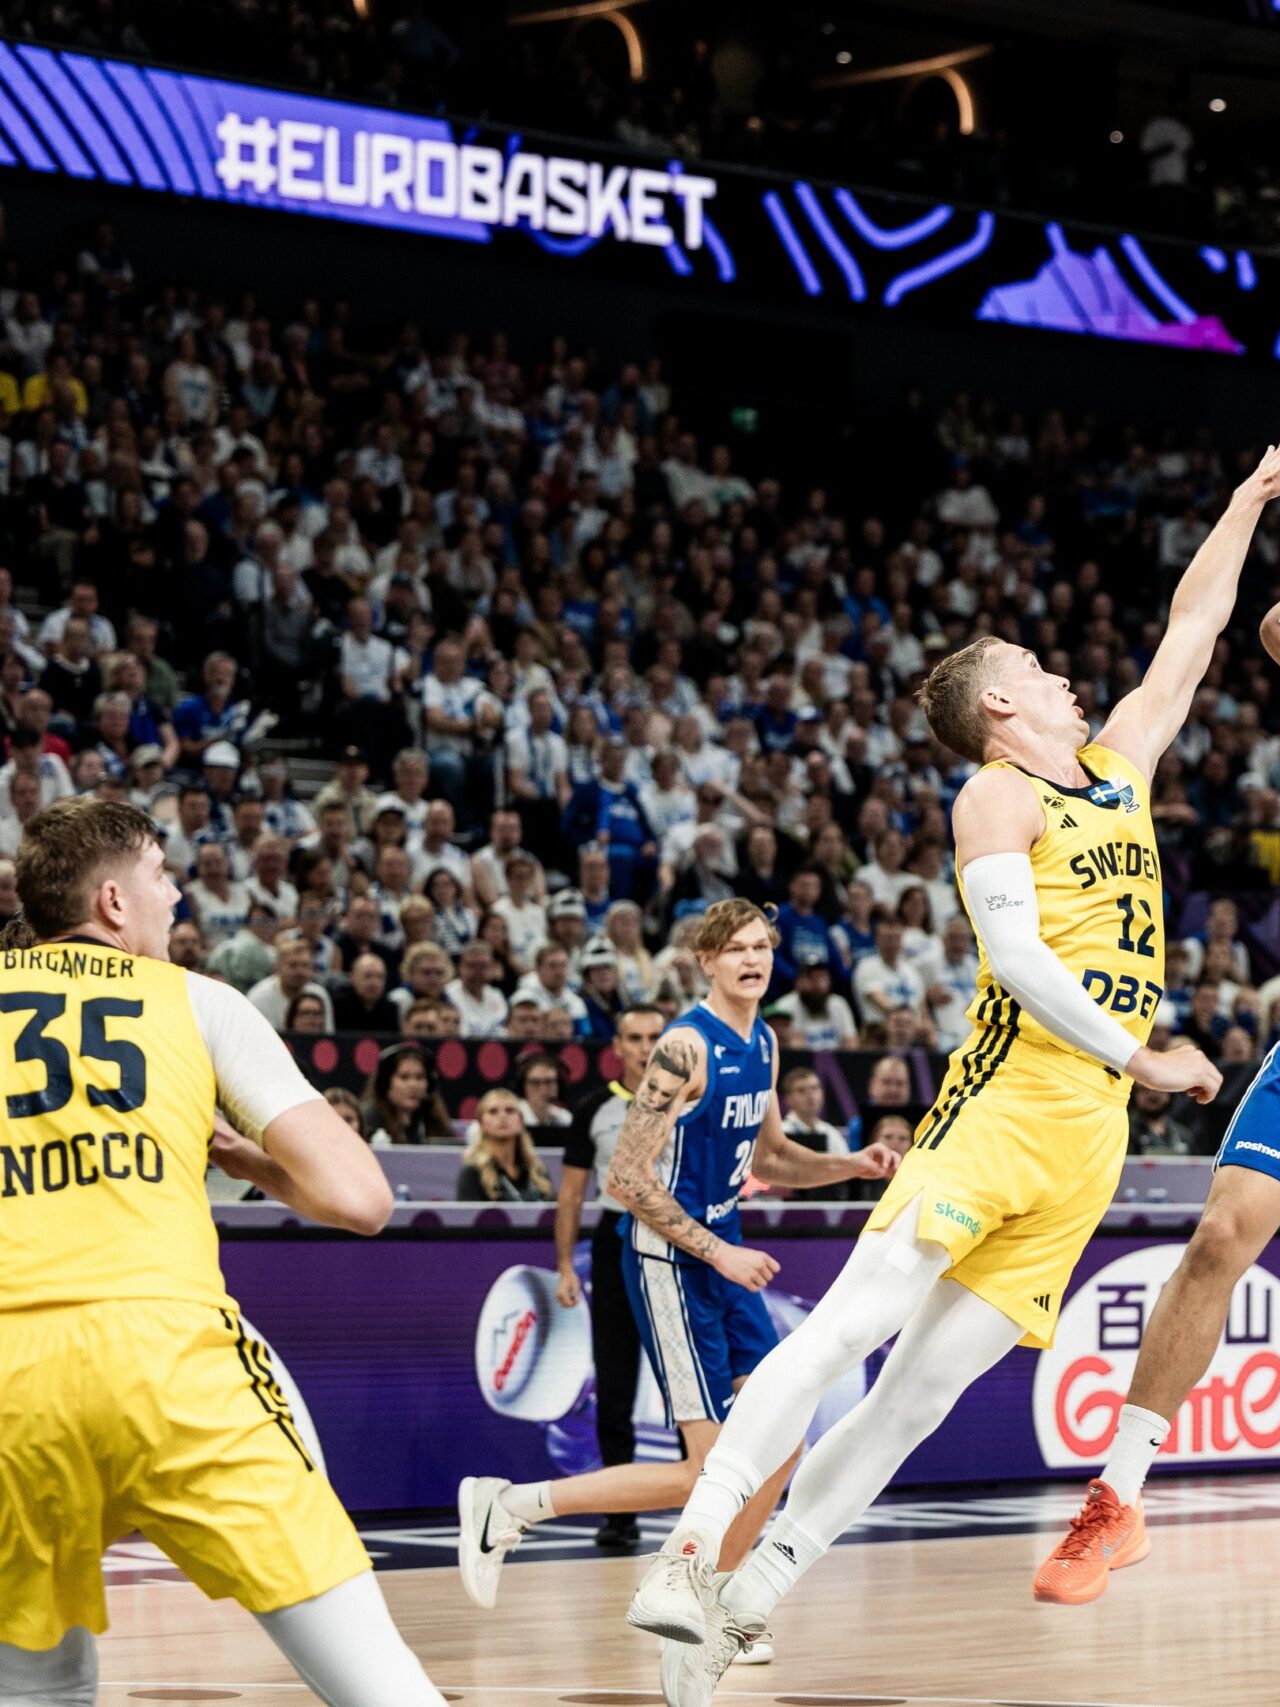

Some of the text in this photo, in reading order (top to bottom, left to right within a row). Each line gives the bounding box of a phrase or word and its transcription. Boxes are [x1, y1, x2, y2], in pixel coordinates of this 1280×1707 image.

[216, 112, 717, 250] #EUROBASKET
[1116, 893, 1156, 958] 12
[4, 949, 134, 979] BIRGANDER
[0, 991, 147, 1119] 35
[0, 1132, 164, 1198] NOCCO
